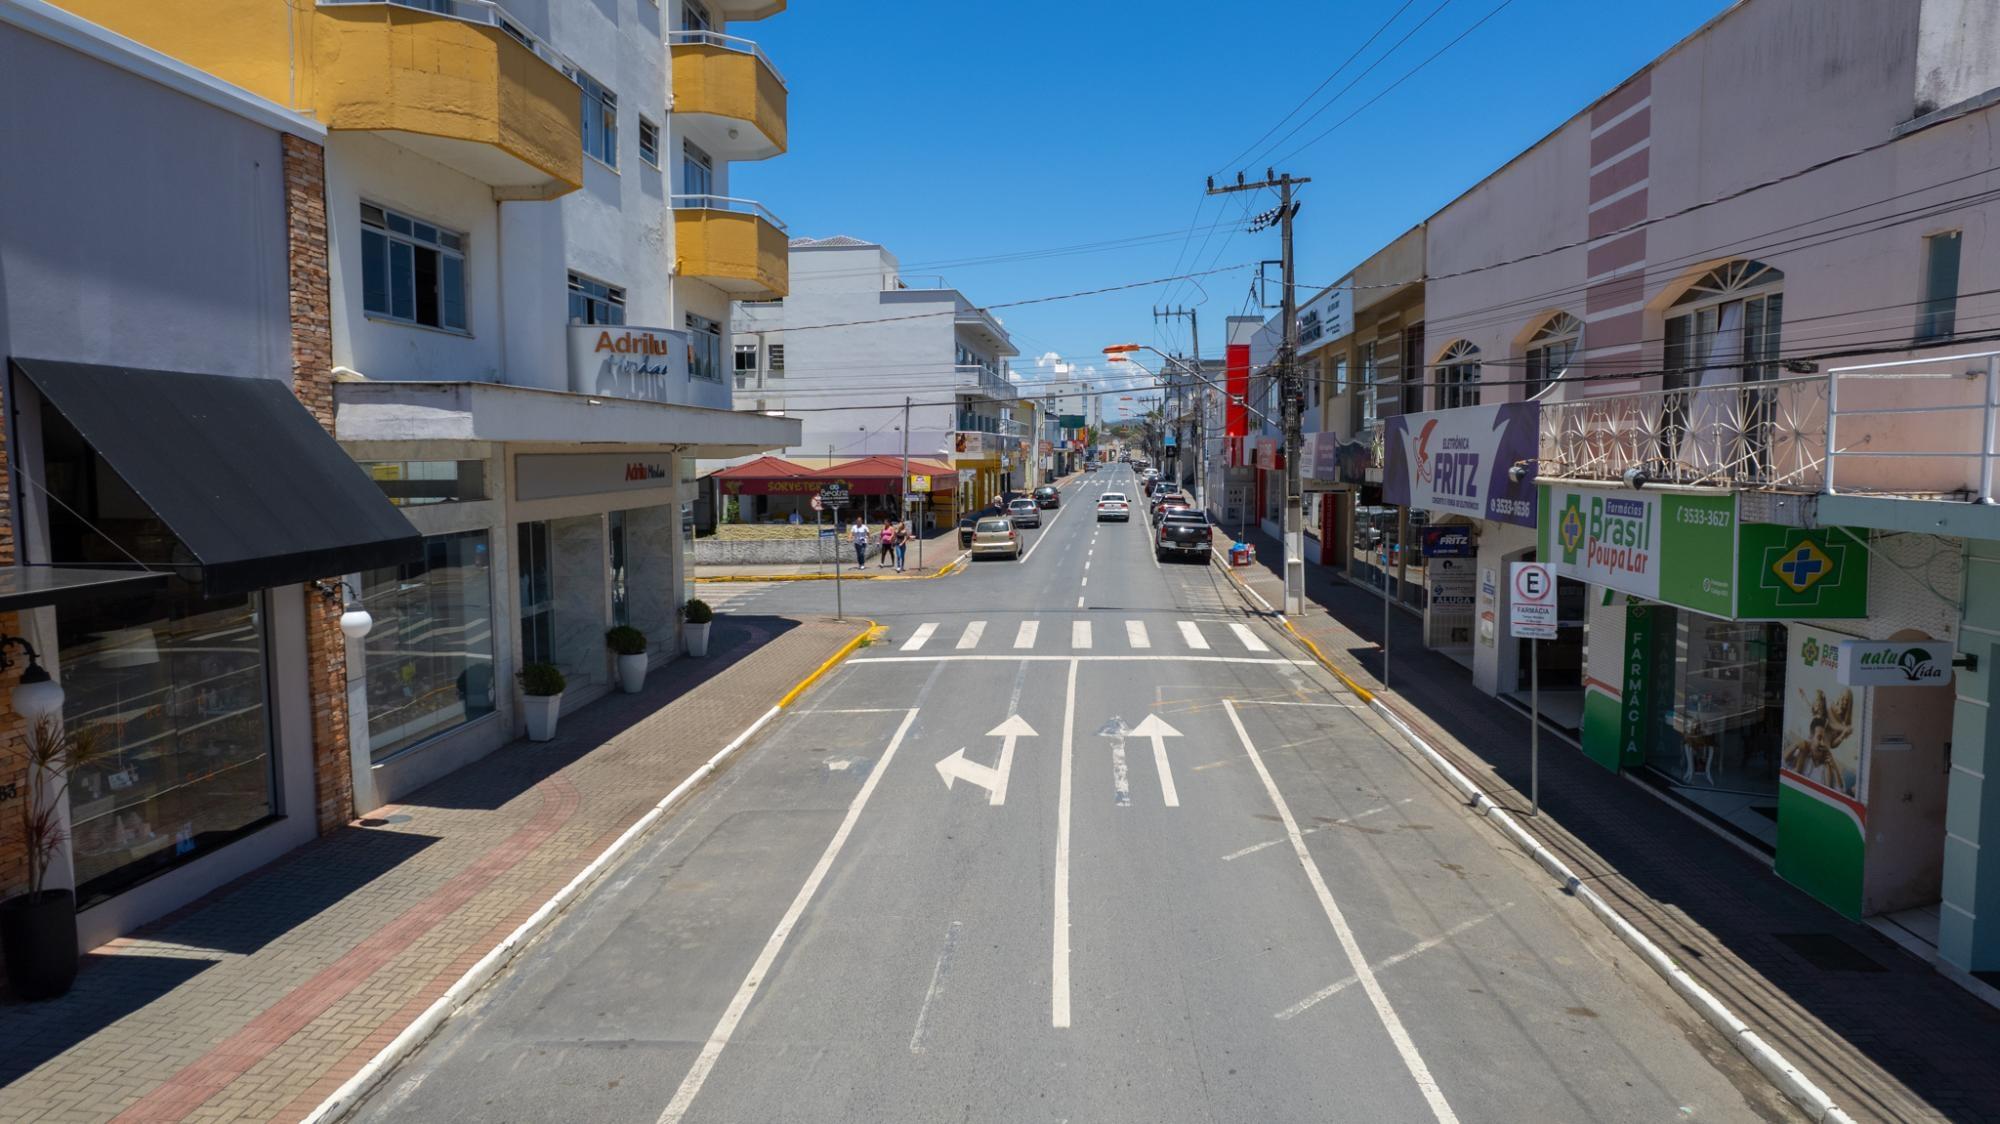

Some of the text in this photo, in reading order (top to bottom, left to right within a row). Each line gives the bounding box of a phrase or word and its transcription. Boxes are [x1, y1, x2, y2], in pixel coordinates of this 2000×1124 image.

[594, 331, 668, 355] Adrilu
[1442, 435, 1469, 450] ELETRÔNICA
[1433, 452, 1480, 498] FRITZ
[1496, 499, 1531, 517] 3533-1636
[1607, 500, 1643, 516] Farmácias
[1590, 496, 1653, 550] Brasil
[1684, 508, 1730, 527] 3533-3627
[1440, 537, 1468, 545] FRITZ
[1587, 536, 1648, 575] Poupa Lar
[1527, 573, 1539, 593] E
[1516, 607, 1550, 615] FARMÁCIA
[1823, 644, 1838, 661] Bra
[1861, 648, 1898, 664] natu
[1626, 632, 1643, 752] FARMÁCIA
